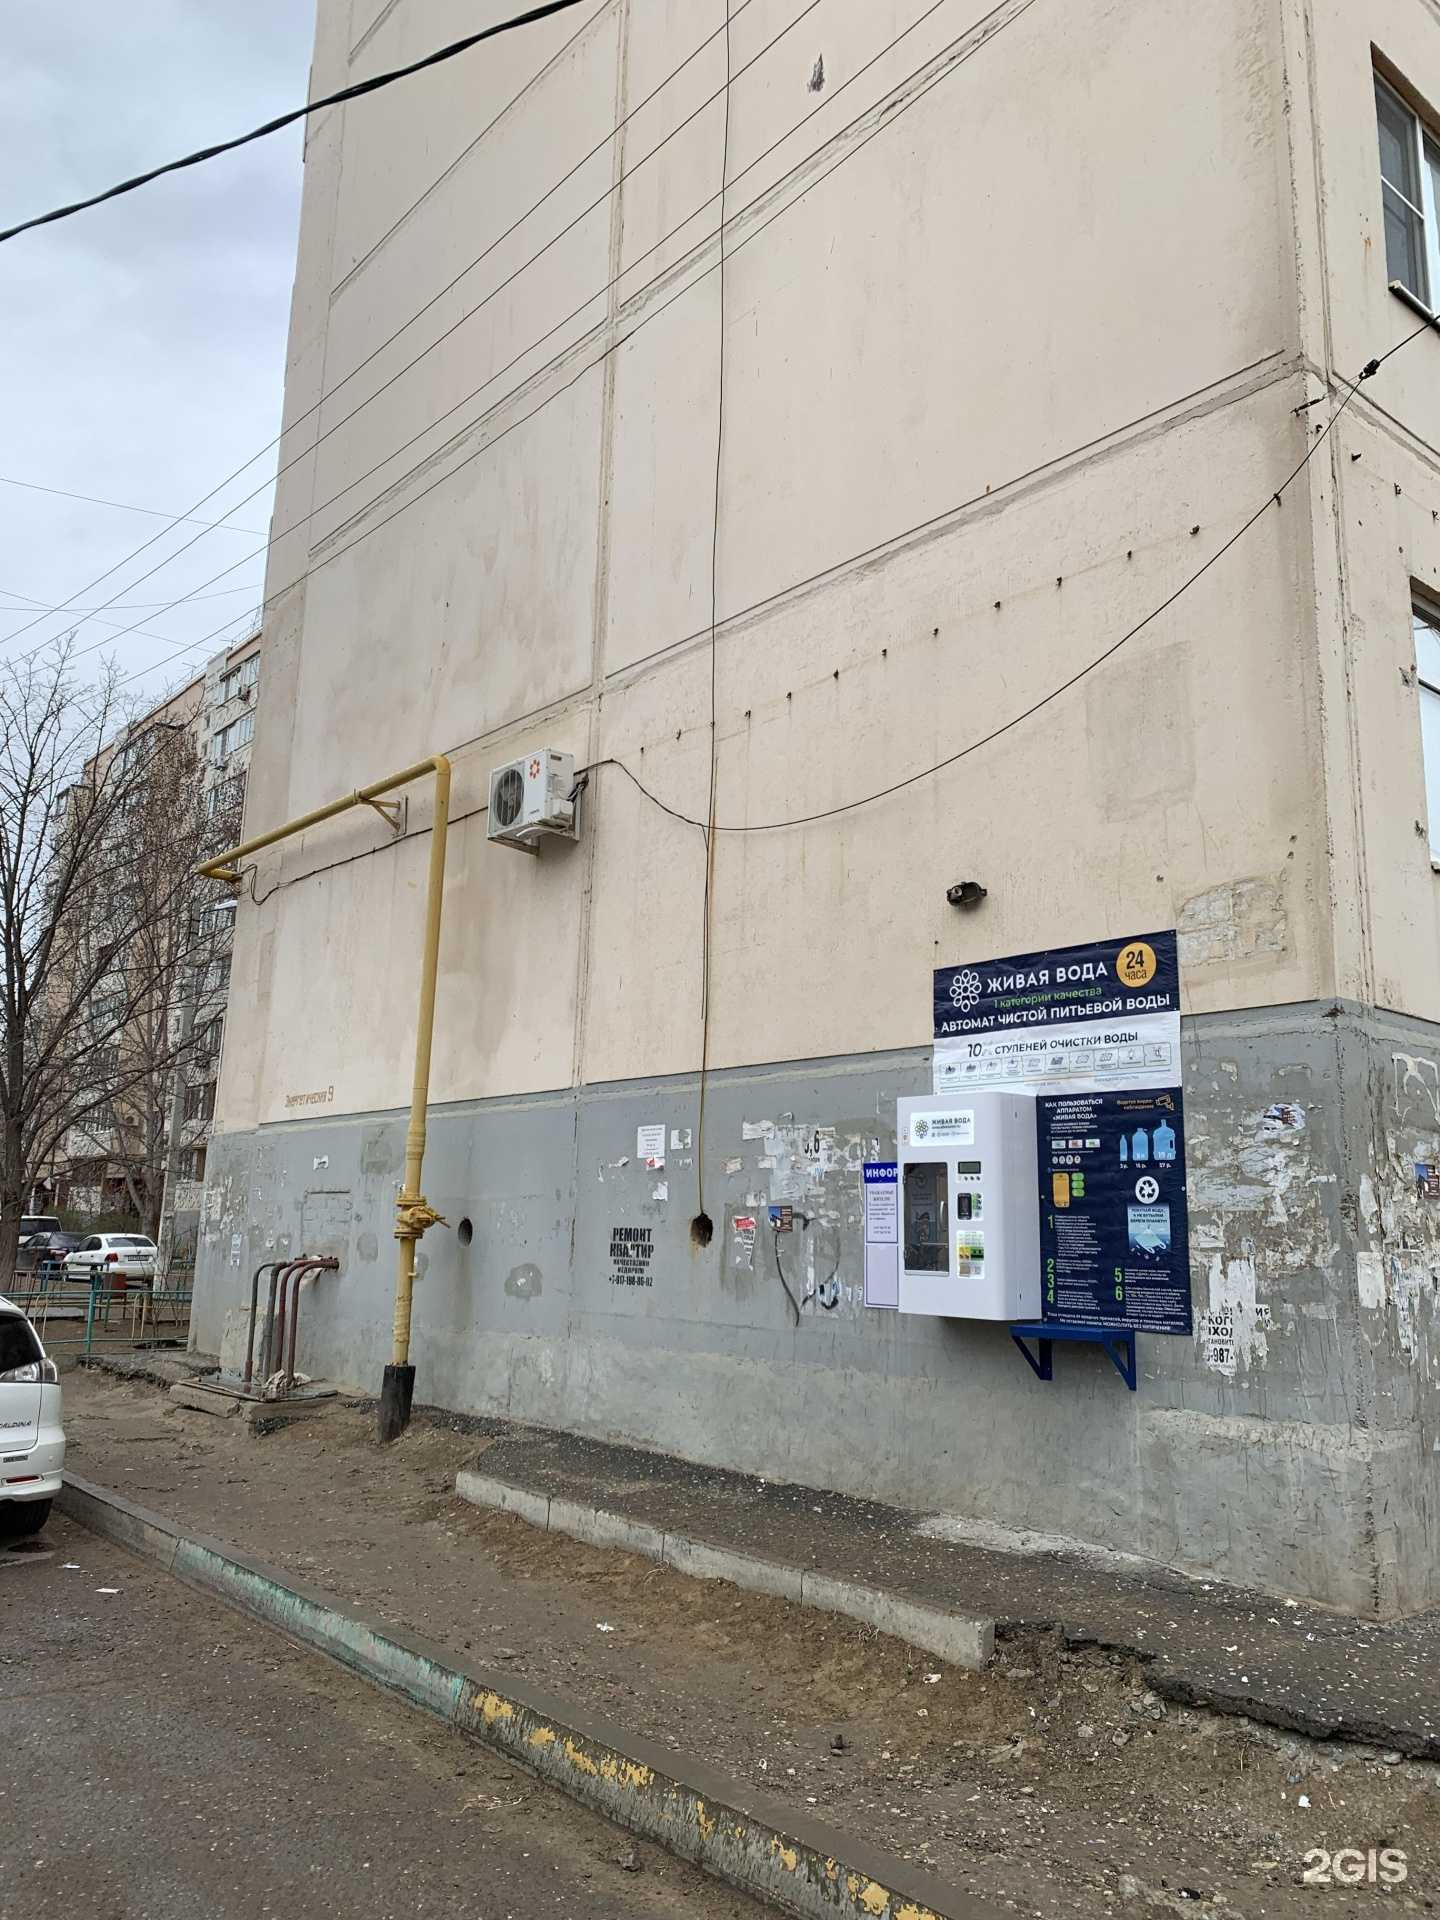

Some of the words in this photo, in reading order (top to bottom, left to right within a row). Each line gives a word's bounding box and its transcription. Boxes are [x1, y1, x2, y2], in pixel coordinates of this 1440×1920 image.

[1126, 950, 1144, 970] 24
[987, 970, 1049, 993] ЖИВАЯ
[1056, 961, 1108, 982] ВОДА
[1125, 969, 1148, 980] часа
[1000, 994, 1051, 1009] категории
[1054, 987, 1102, 1000] качества
[941, 1016, 995, 1033] АВТОМАТ
[998, 1007, 1047, 1024] ЧИСТОЙ
[1051, 997, 1122, 1019] ПИТЬЕВОЙ
[1126, 994, 1170, 1010] ВОДЫ
[968, 1043, 982, 1057] 10
[995, 1040, 1047, 1055] СТУПЕНЕЙ
[1050, 1036, 1101, 1048] ОЧИСТКИ
[1104, 1032, 1138, 1043] ВОДЫ
[328, 1086, 334, 1102] 9
[1058, 1098, 1103, 1107] ПОЛЬЗОВАТЬСЯ
[954, 1116, 970, 1124] ВОДА
[1048, 1215, 1054, 1229] 1
[613, 1227, 652, 1242] РЕМОНТ
[1047, 1258, 1054, 1273] 2
[1048, 1274, 1054, 1288] 3
[1115, 1267, 1122, 1282] 5
[1047, 1289, 1054, 1304] 4
[1115, 1285, 1123, 1301] 6
